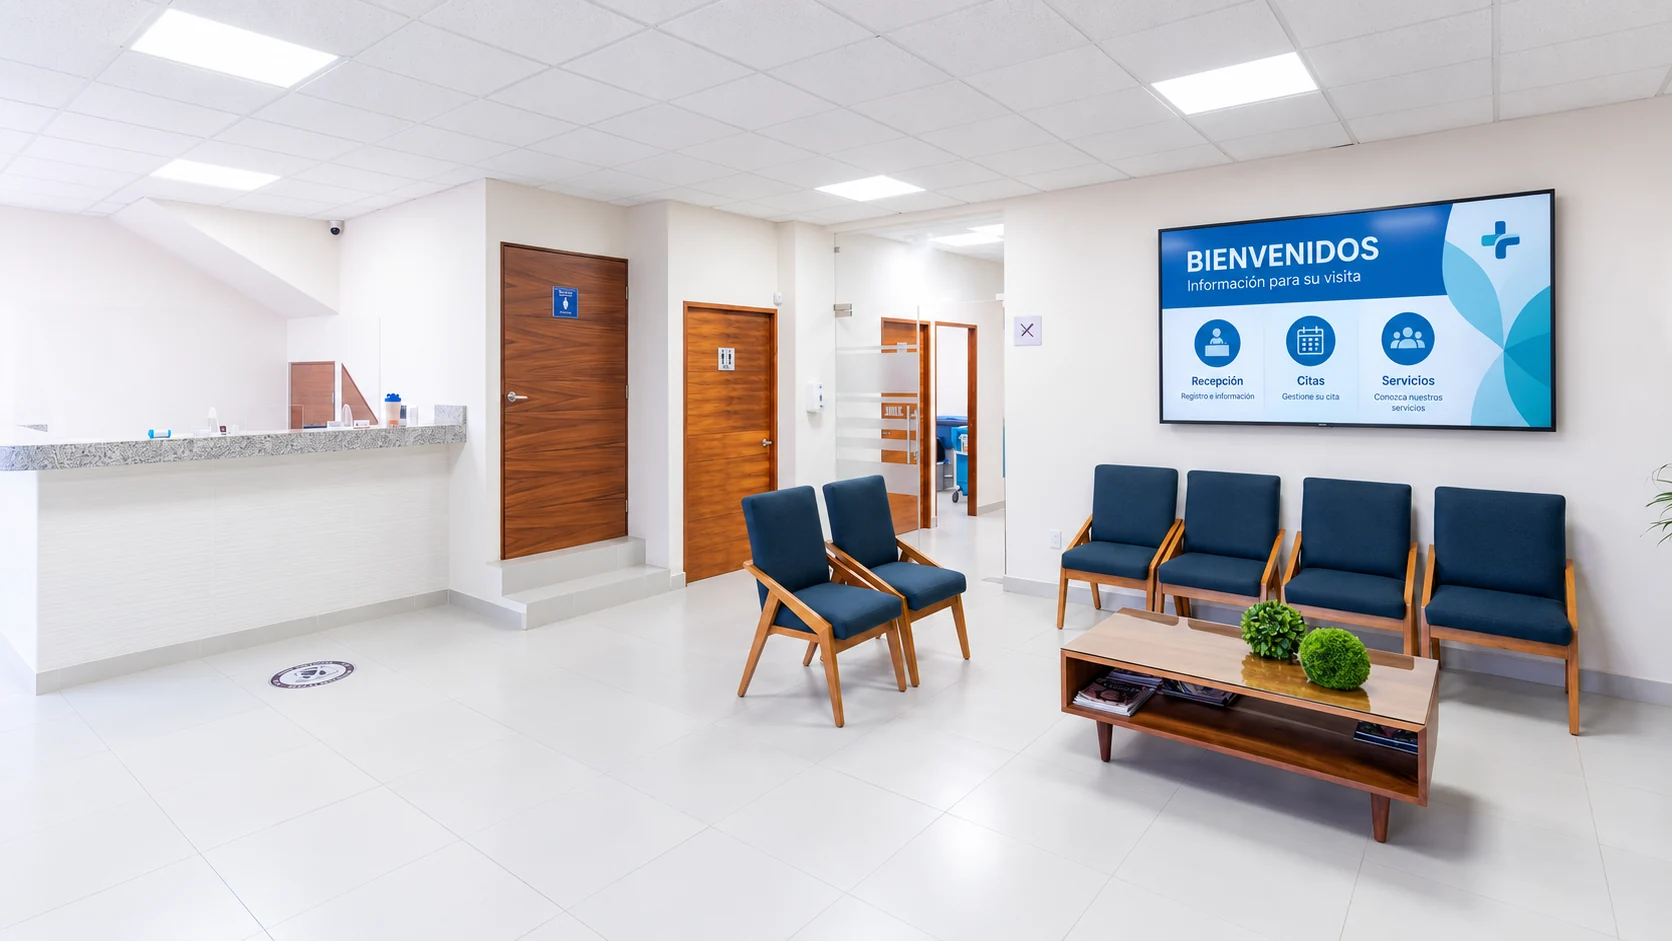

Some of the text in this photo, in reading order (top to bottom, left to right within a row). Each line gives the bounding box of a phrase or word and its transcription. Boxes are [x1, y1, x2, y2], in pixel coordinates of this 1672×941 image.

[1187, 235, 1379, 272] BIENVENIDOS
[1187, 270, 1361, 292] Información para su visita
[1191, 375, 1244, 388] Recepción
[1297, 375, 1325, 386] Citas
[1382, 375, 1435, 386] Servicios
[1180, 392, 1208, 401] Registro
[1215, 392, 1255, 400] información
[1281, 392, 1314, 401] Gestione
[1325, 393, 1340, 401] cita
[1373, 392, 1443, 402] Conozca nuestros
[1391, 404, 1426, 412] servicios
